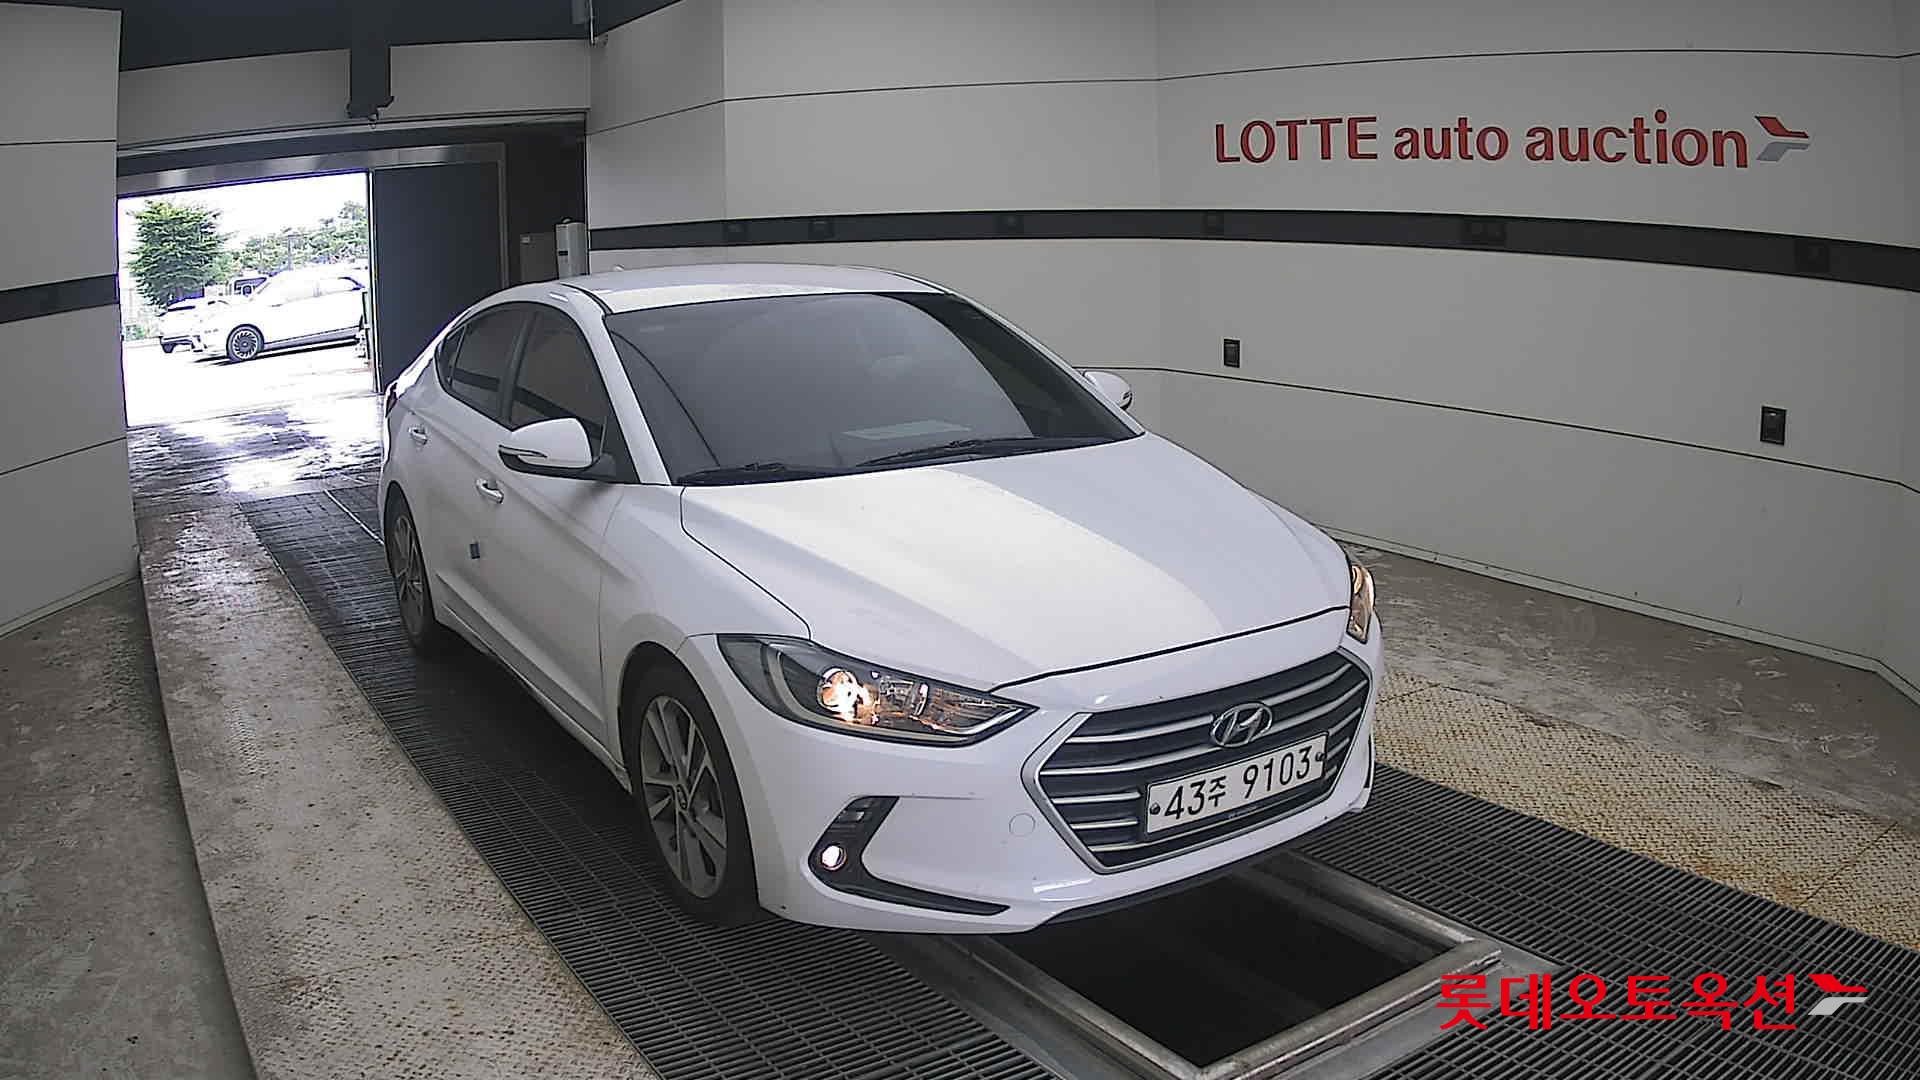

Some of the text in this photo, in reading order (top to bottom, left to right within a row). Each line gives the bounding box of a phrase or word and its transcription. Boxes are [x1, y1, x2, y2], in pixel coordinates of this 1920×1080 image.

[1215, 109, 1748, 168] LOTTE auto auction
[1164, 745, 1313, 820] 43주 9103
